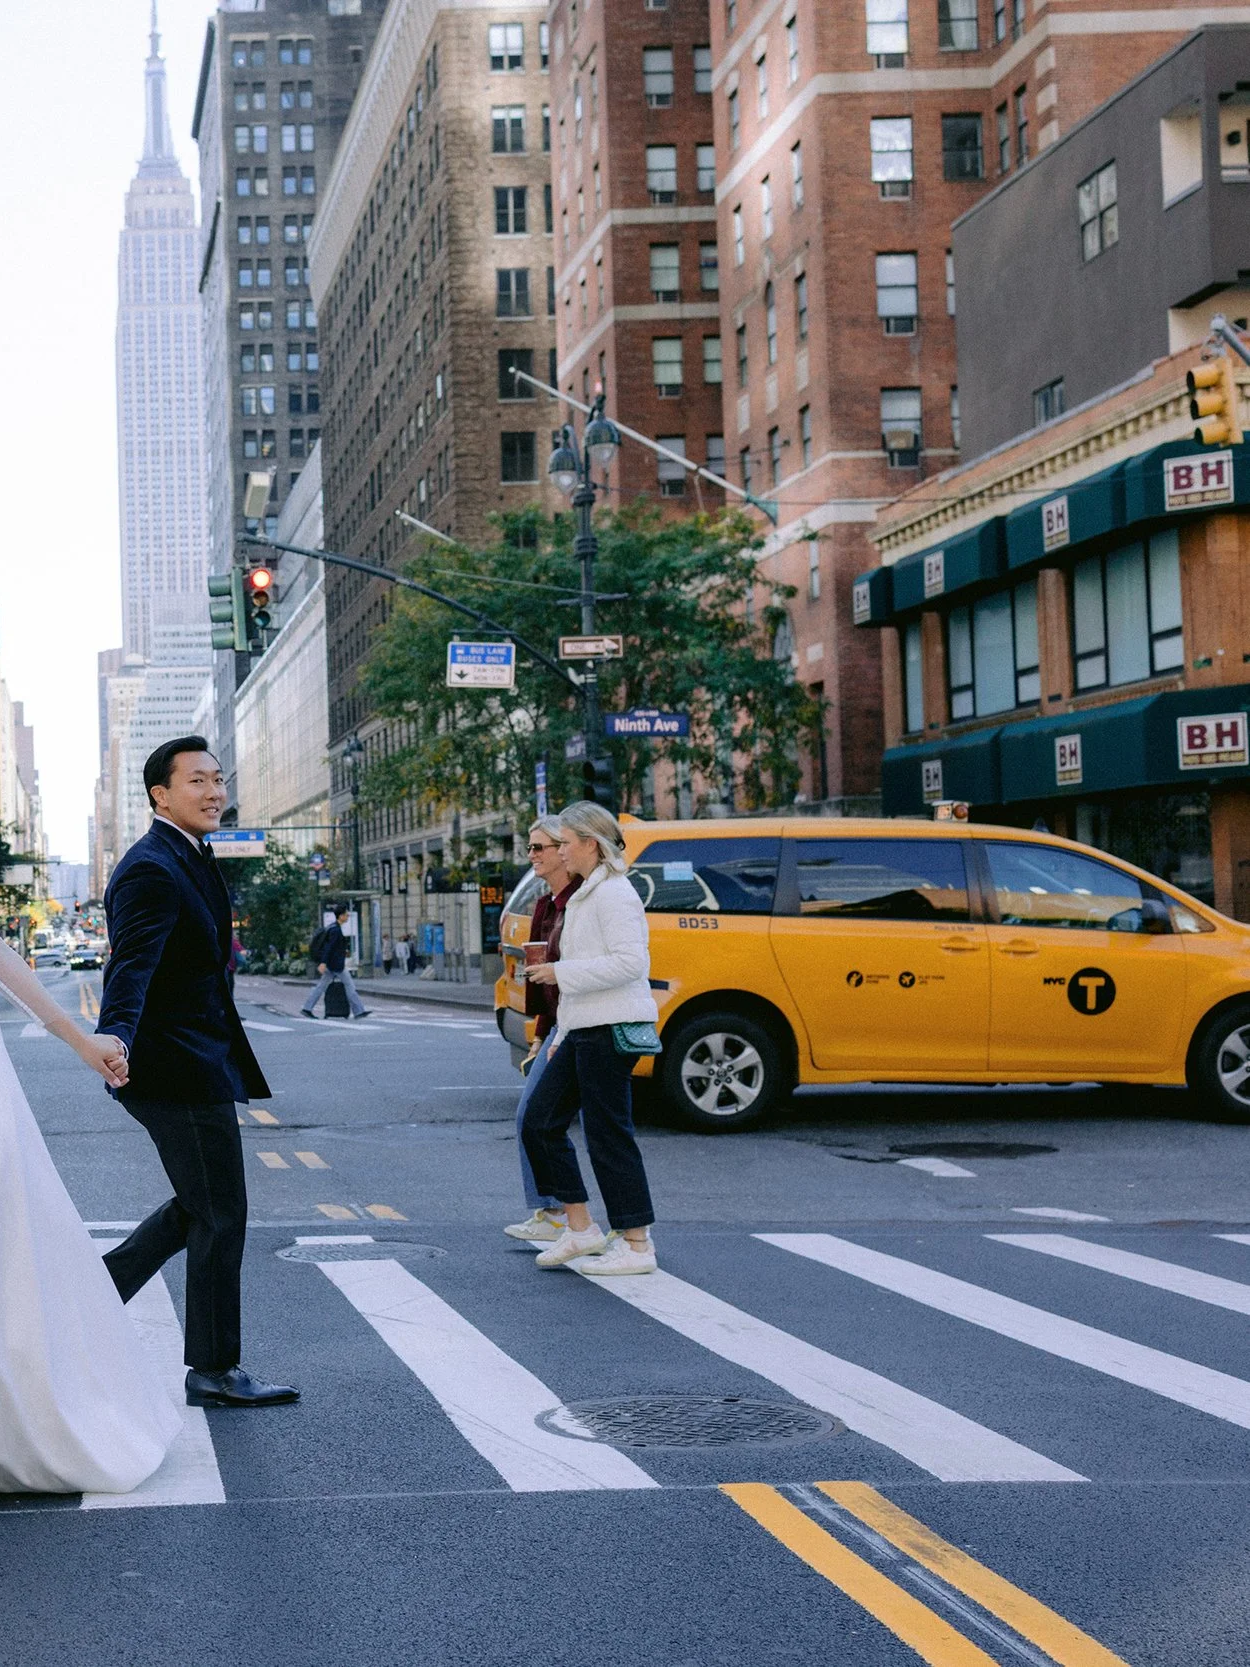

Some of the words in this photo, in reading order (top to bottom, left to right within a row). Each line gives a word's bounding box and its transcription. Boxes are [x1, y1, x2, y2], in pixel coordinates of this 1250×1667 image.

[487, 647, 508, 655] LANE
[614, 718, 650, 732] Ninth
[653, 718, 679, 732] Ave
[1043, 977, 1066, 985] NYC
[1077, 976, 1106, 1010] T
